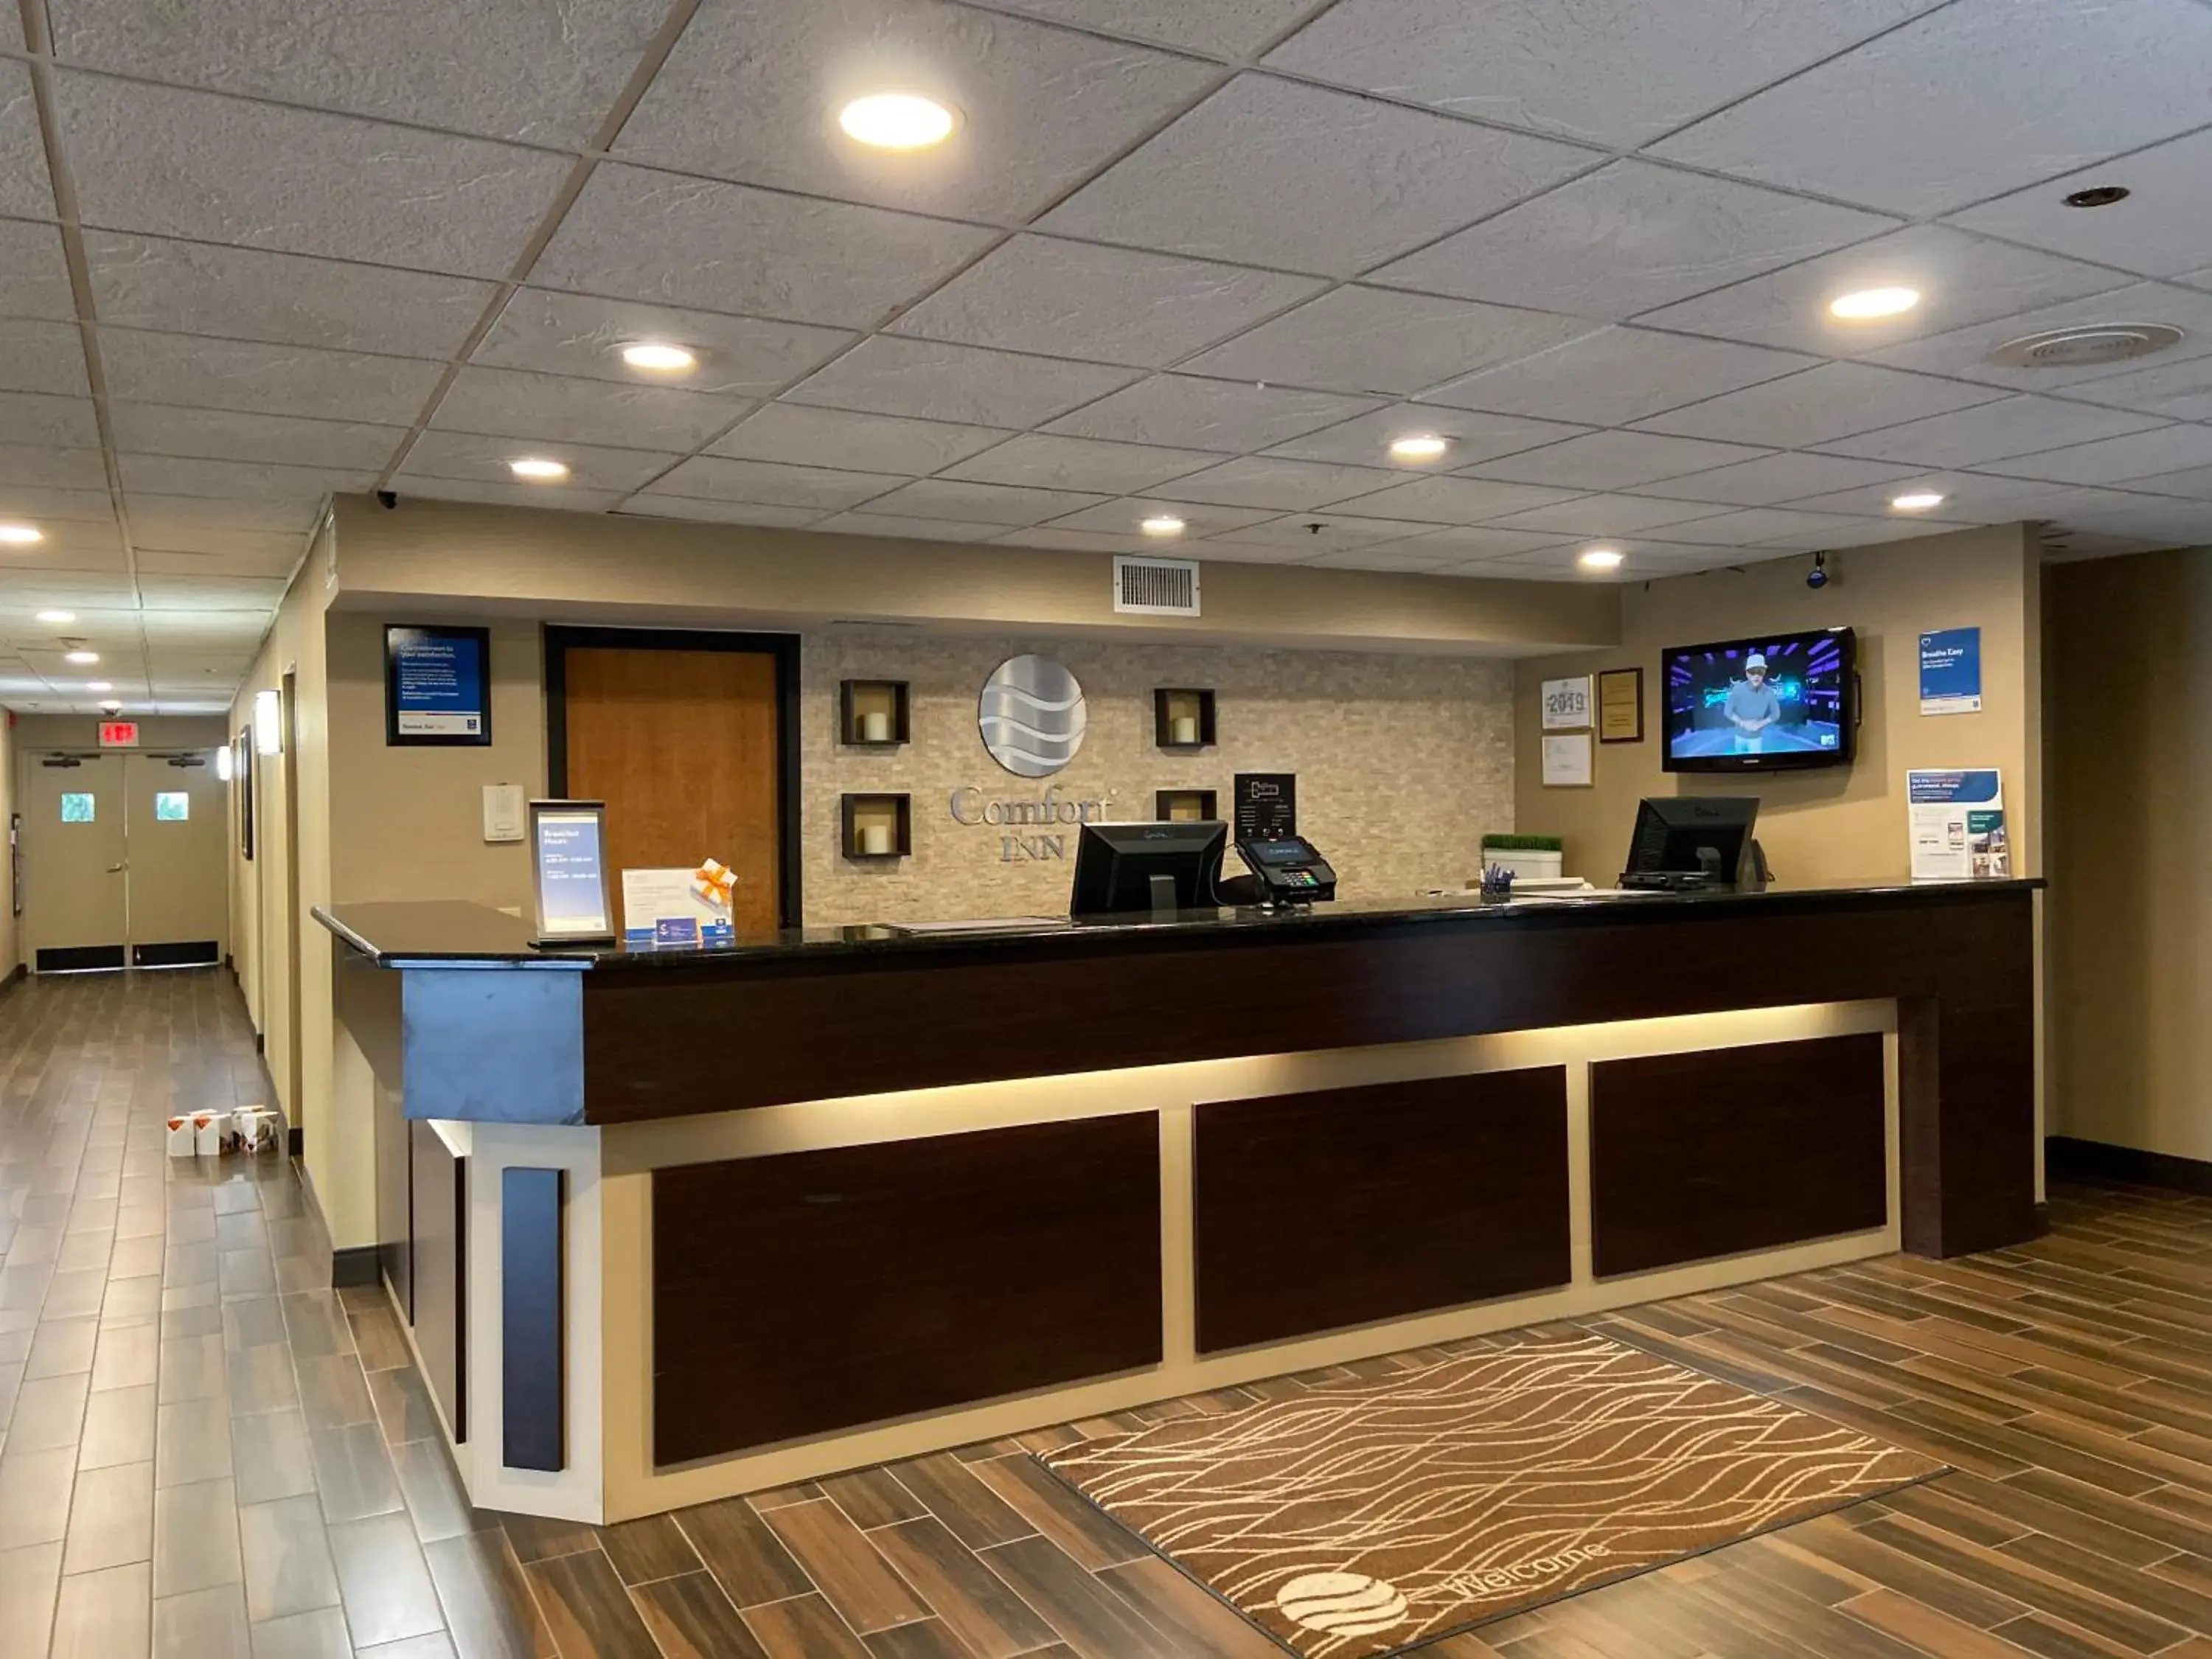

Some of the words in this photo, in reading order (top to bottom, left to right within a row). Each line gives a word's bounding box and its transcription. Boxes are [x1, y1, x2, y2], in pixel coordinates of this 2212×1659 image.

[1922, 650, 1947, 658] Breathe
[1947, 648, 1964, 657] Easy
[1548, 692, 1585, 713] 2019
[951, 783, 1115, 825] Comfort
[1000, 834, 1064, 862] INN
[1440, 1543, 1610, 1597] Welcome
